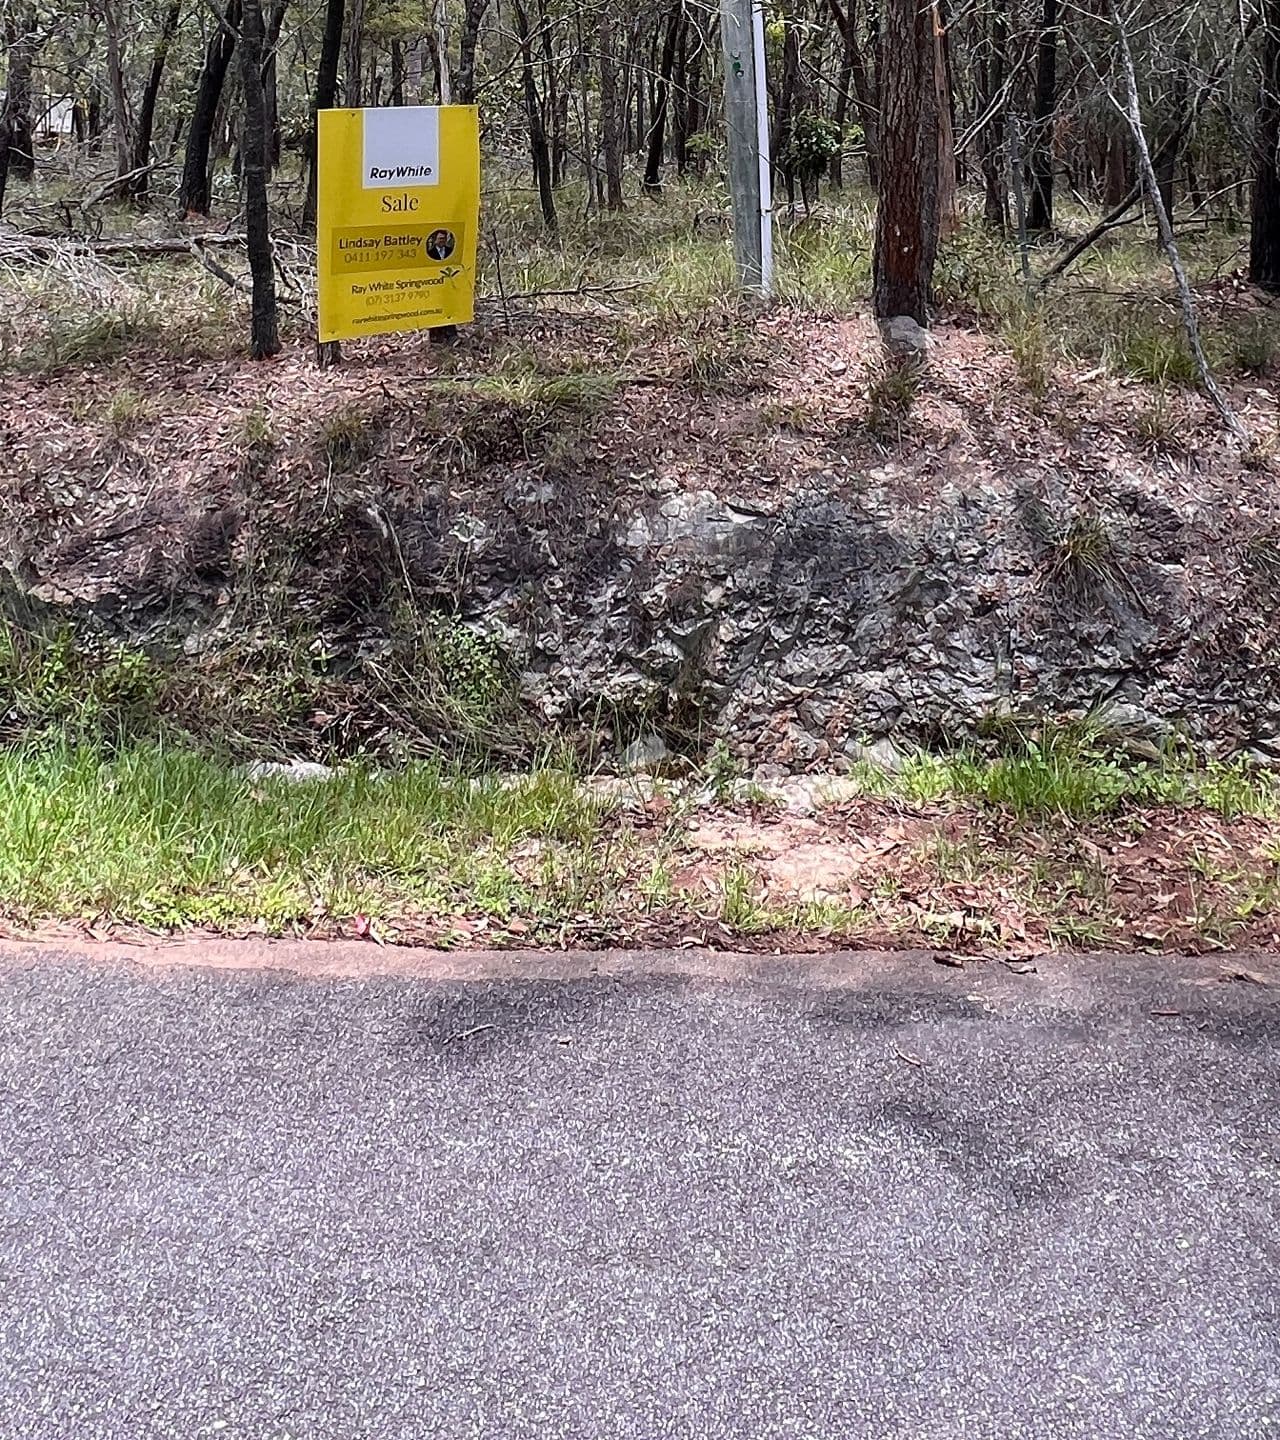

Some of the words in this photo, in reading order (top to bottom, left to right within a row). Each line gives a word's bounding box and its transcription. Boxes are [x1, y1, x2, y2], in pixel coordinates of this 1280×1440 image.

[381, 193, 419, 213] Sale
[339, 237, 381, 250] Lindsay
[384, 234, 422, 247] Battley
[344, 251, 370, 263] 0411
[352, 284, 366, 295] Ray
[368, 281, 394, 292] White
[396, 276, 444, 290] Springwood
[383, 292, 406, 304] 3137
